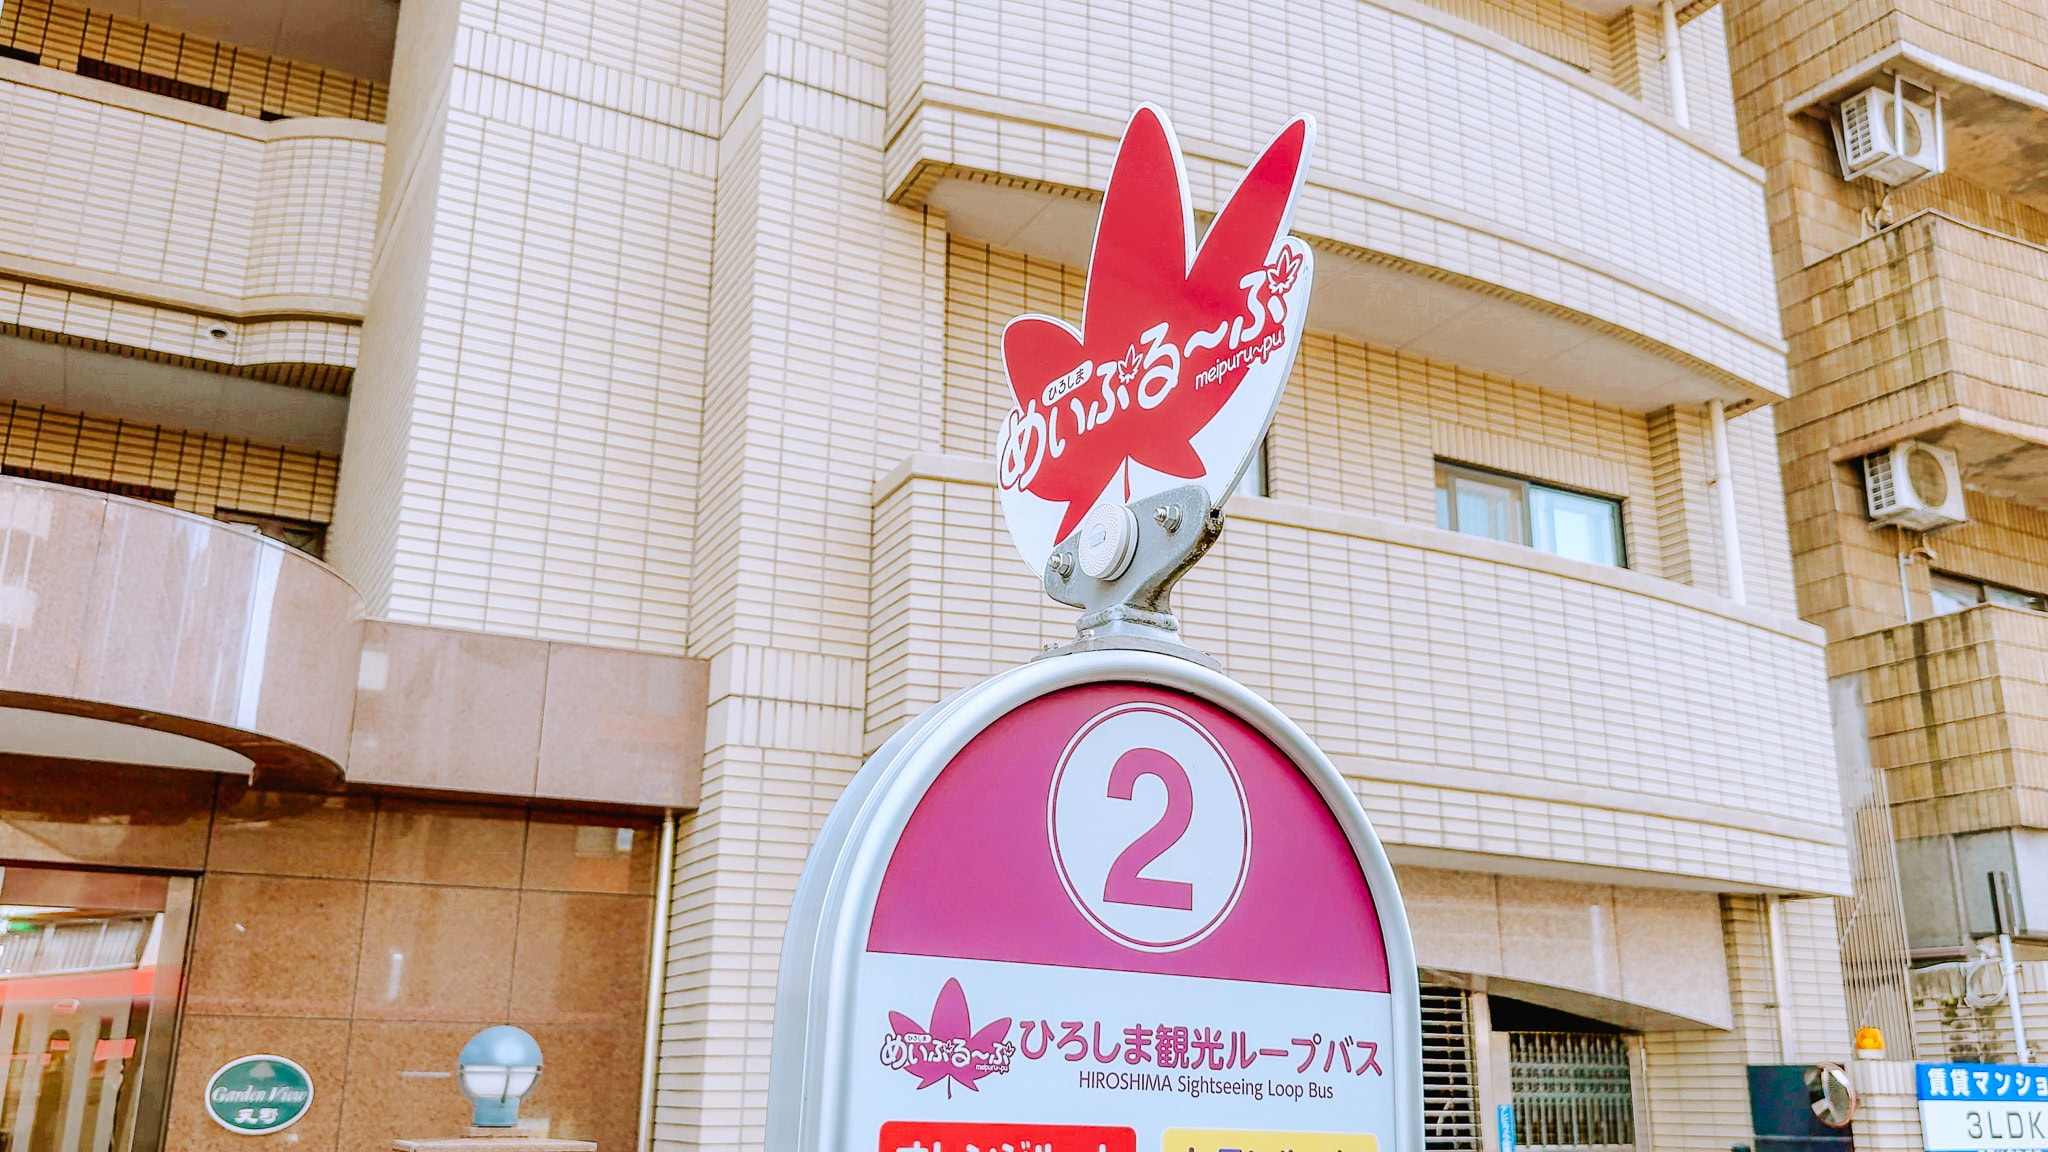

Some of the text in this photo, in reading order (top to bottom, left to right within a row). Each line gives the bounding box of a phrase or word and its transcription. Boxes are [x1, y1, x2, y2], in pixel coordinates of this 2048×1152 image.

[1047, 367, 1086, 401] ひろしま
[1103, 747, 1193, 911] 2
[1019, 1019, 1383, 1077] ひろしま観光ループバス
[212, 1084, 308, 1103] Garden View
[1078, 1070, 1334, 1102] HIROSHIMA Sightseeing Loop Bus
[1966, 1111, 2046, 1139] 3LDK
